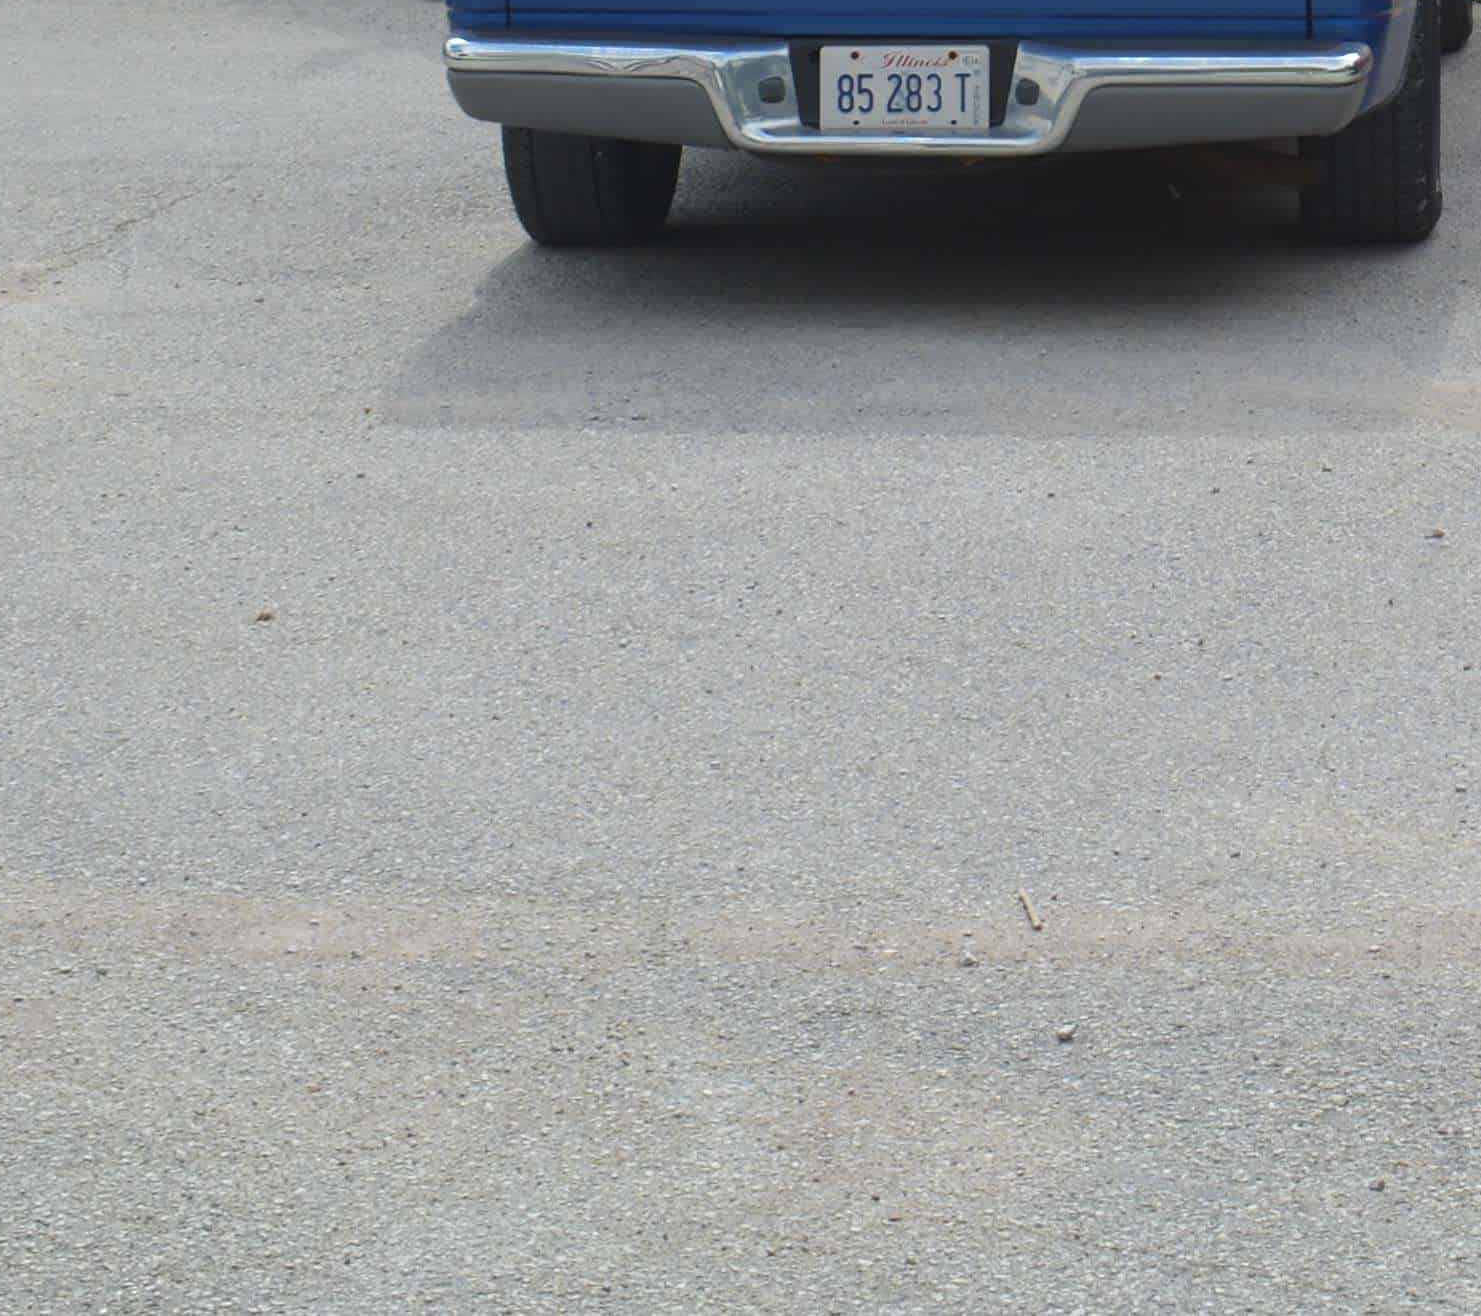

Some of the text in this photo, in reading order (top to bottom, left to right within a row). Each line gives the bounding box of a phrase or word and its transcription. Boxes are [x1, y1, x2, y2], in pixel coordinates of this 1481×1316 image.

[881, 50, 950, 69] Illinois
[837, 73, 874, 113] 85
[886, 73, 942, 113] 283
[954, 73, 972, 113] T
